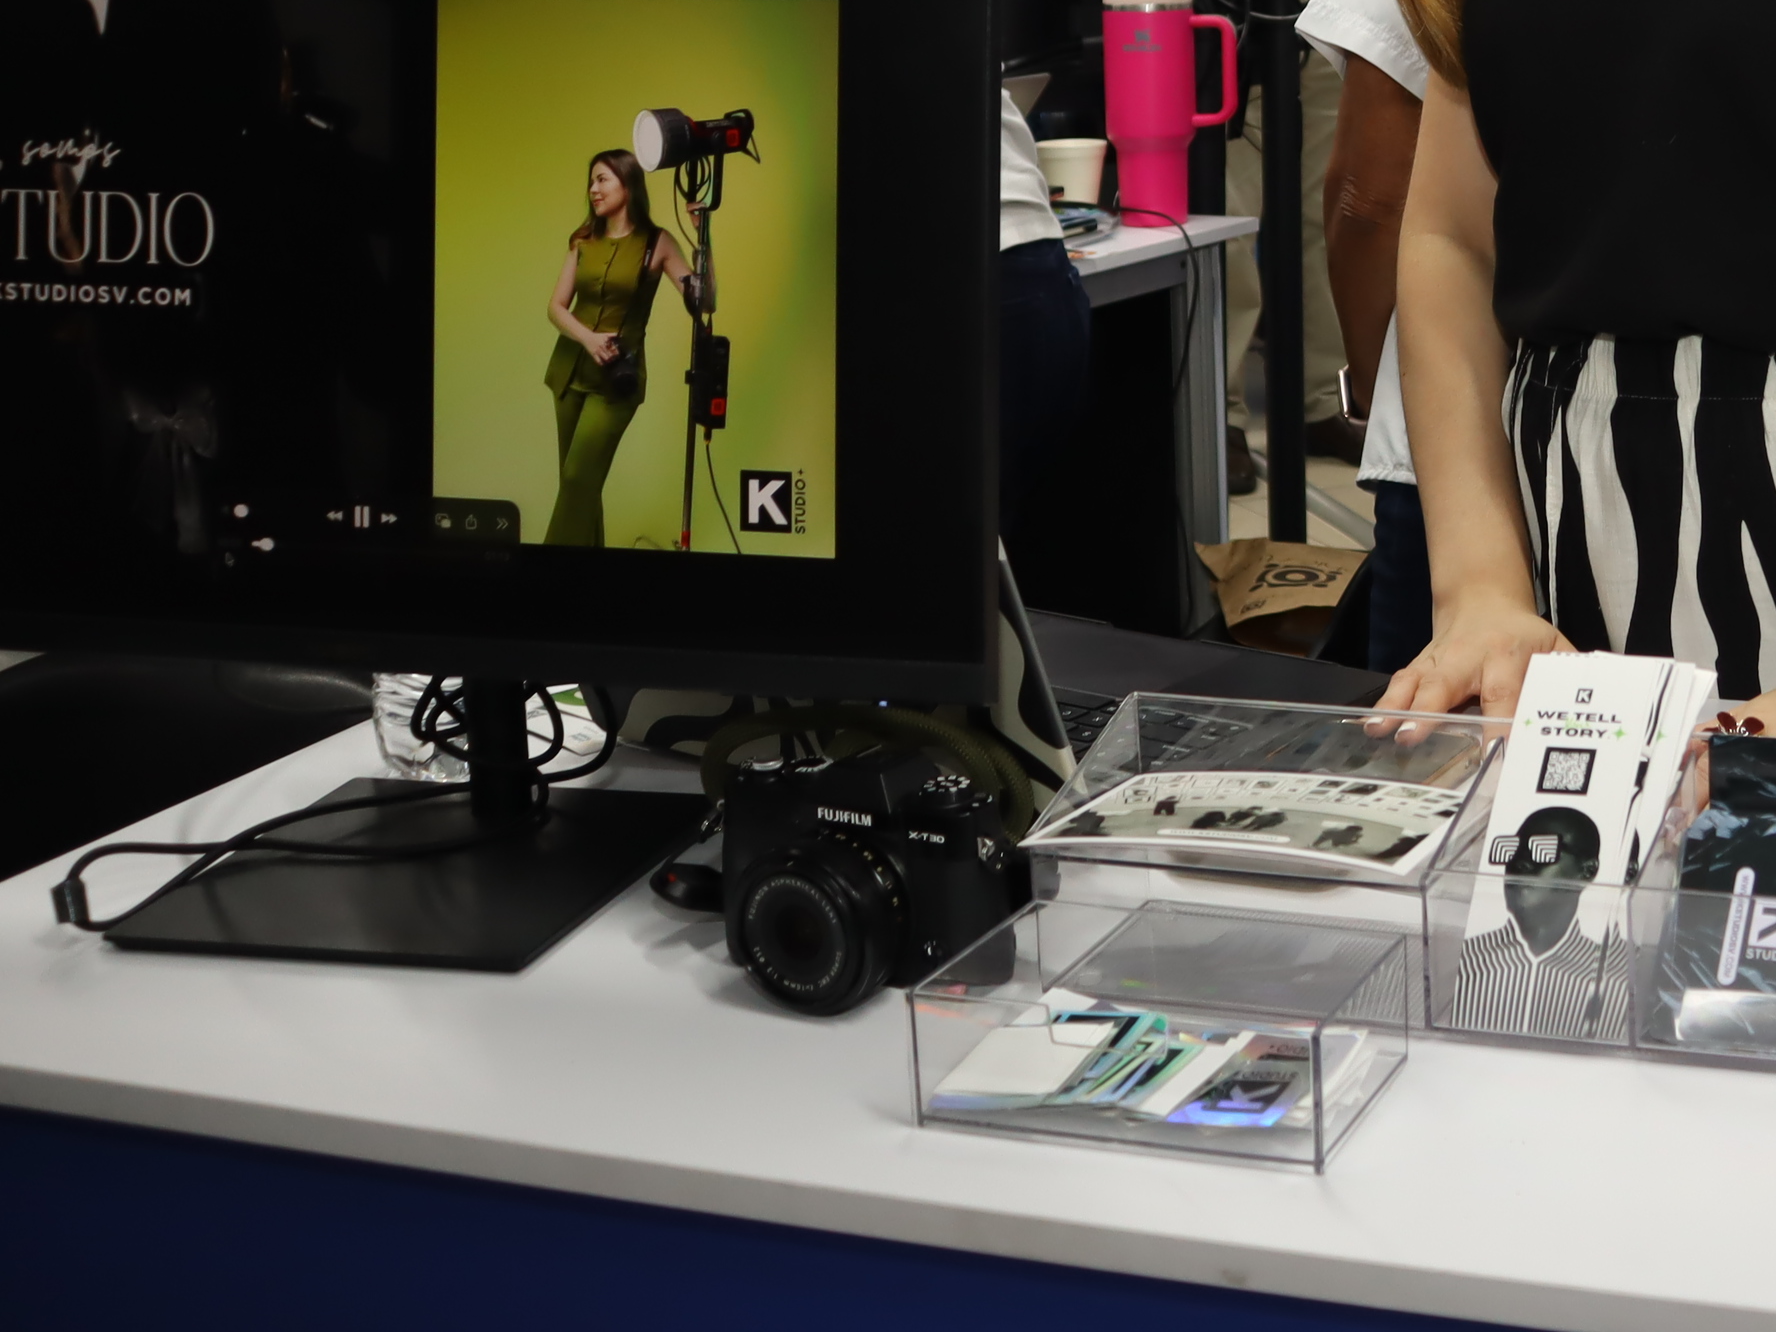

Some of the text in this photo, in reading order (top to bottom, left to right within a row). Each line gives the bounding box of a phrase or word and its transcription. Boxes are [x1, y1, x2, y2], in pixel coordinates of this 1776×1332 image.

[748, 479, 788, 525] K
[795, 478, 806, 535] STUDIO
[1537, 711, 1568, 721] WE
[1574, 712, 1622, 723] TELL
[817, 807, 872, 827] FUJIFILM
